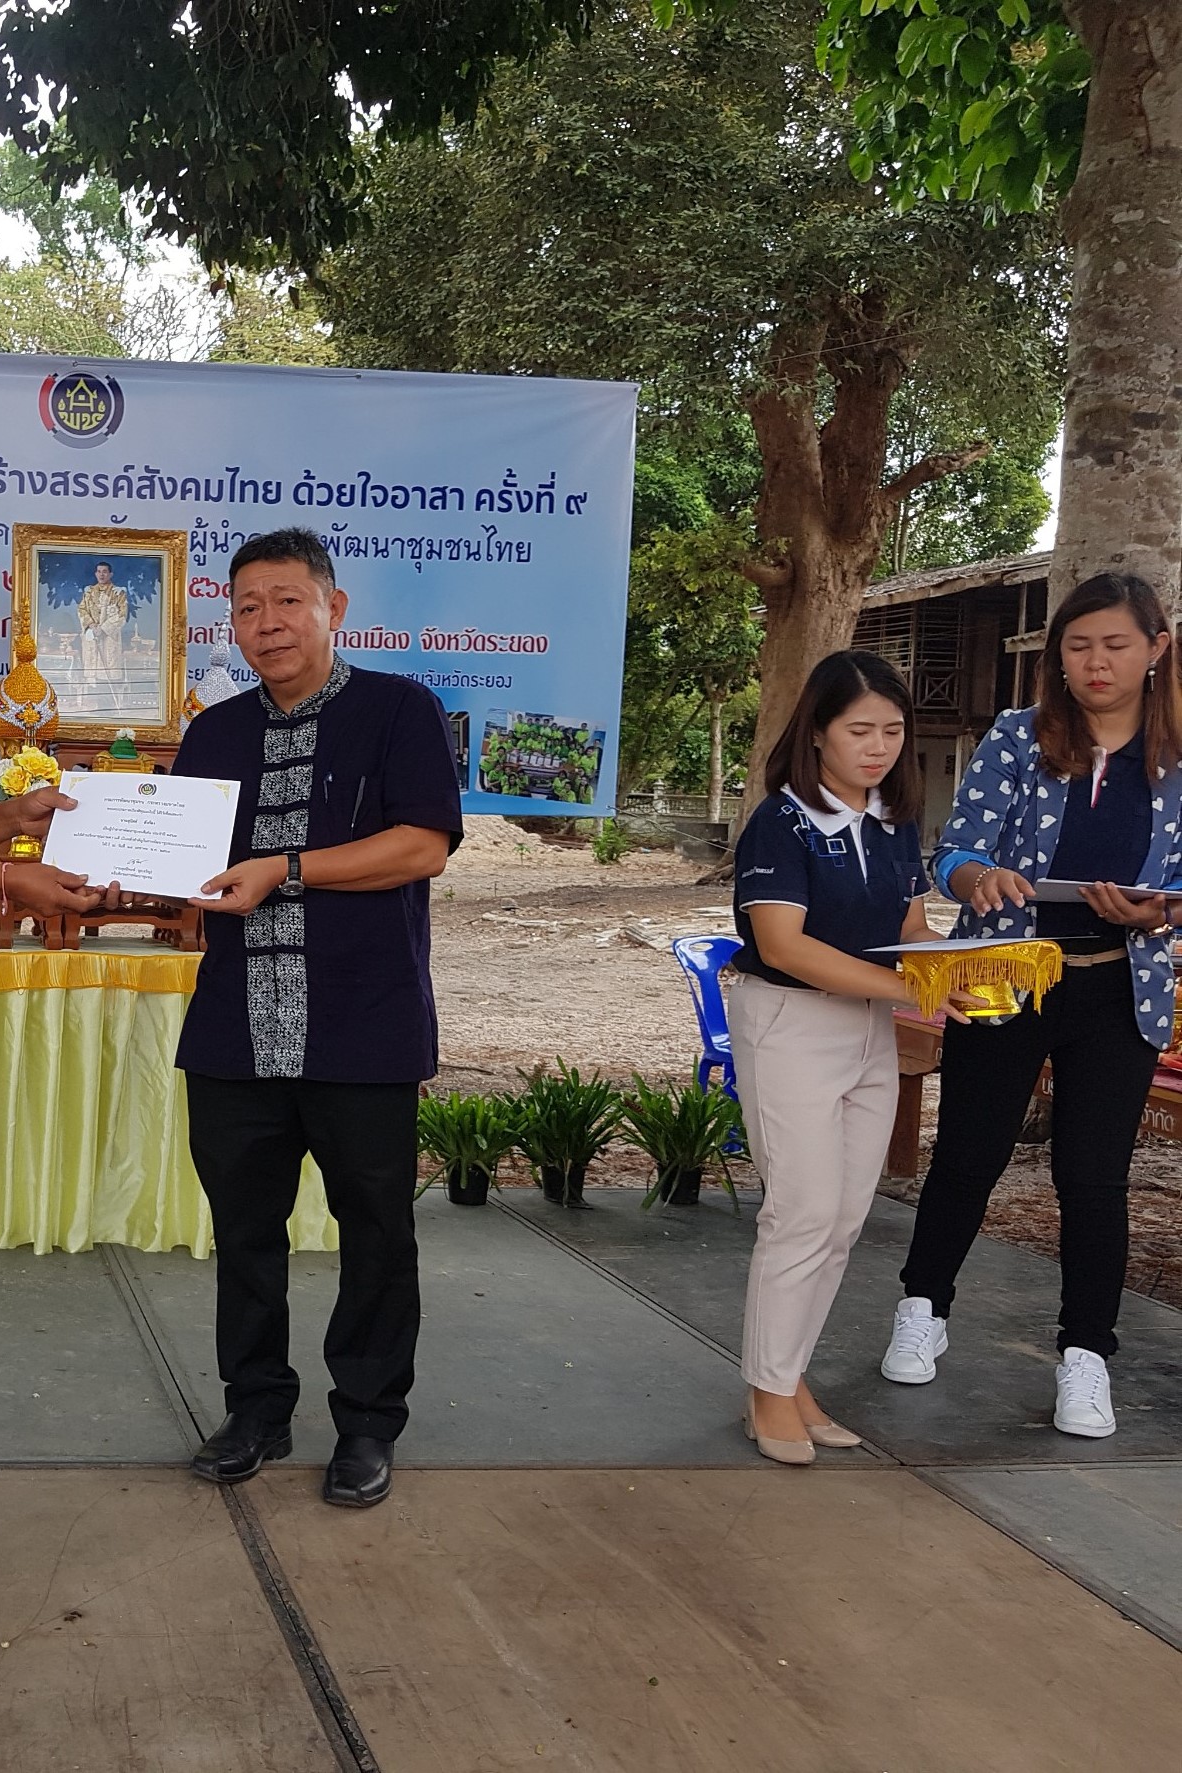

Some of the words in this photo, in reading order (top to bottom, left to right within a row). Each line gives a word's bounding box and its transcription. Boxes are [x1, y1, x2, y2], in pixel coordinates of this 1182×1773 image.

[293, 470, 465, 512] ด้วยใจอาสา
[475, 468, 556, 515] ครั้งที่
[321, 522, 533, 573] พัฒนาชุมชนไทย
[421, 625, 549, 654] จังหวัดระยอง
